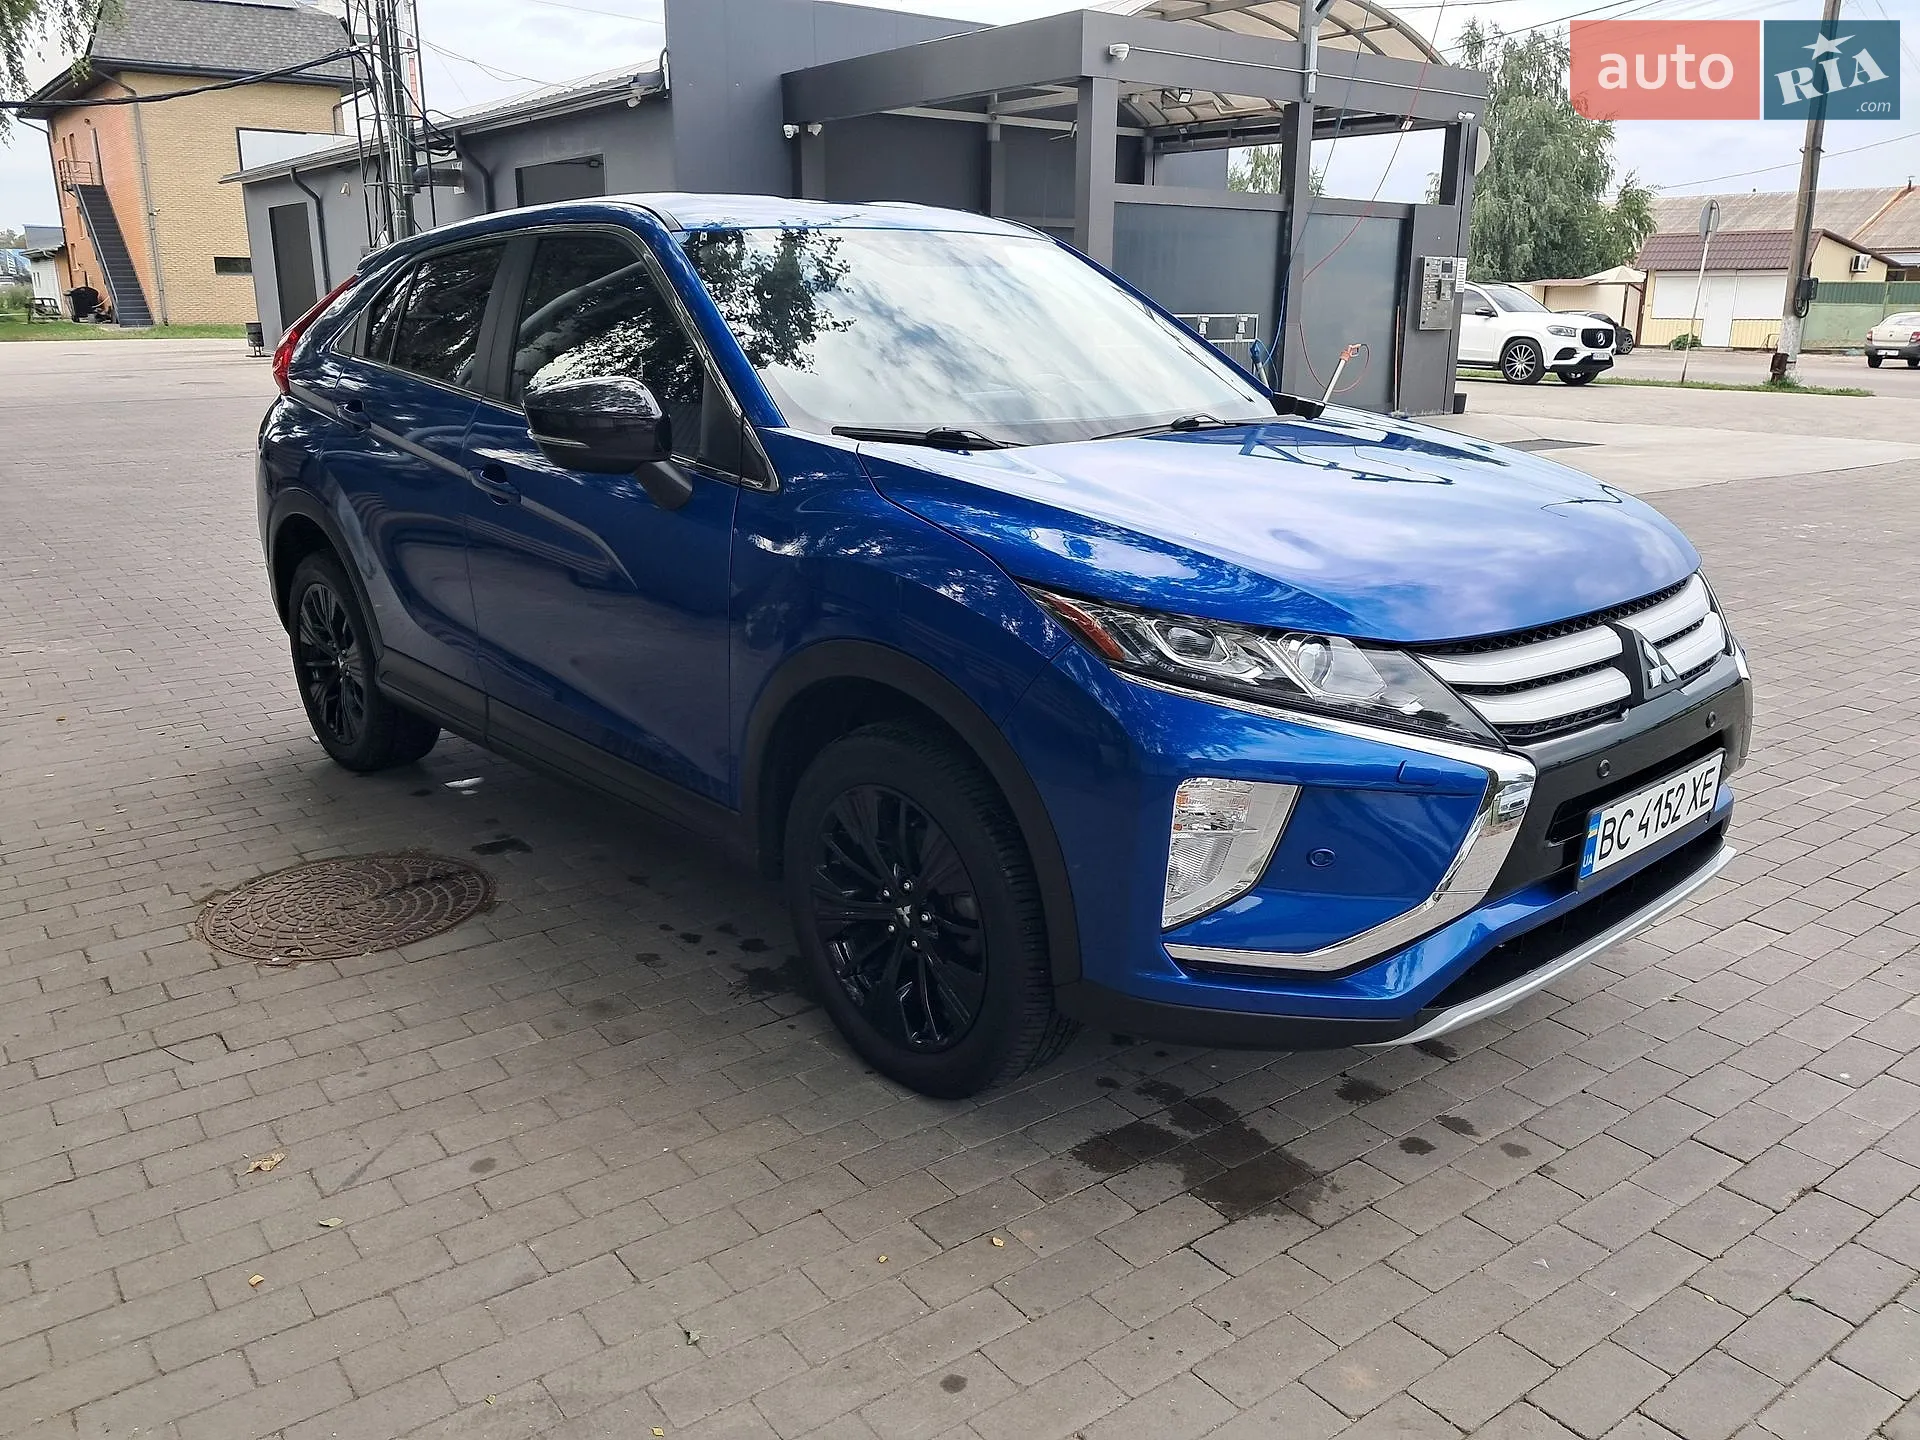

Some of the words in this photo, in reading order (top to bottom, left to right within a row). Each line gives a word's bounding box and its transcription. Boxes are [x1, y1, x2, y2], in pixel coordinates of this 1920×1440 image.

[1599, 809, 1634, 861] BC
[1638, 783, 1685, 838] 4152
[1686, 767, 1716, 816] XE
[1582, 853, 1593, 867] UA
